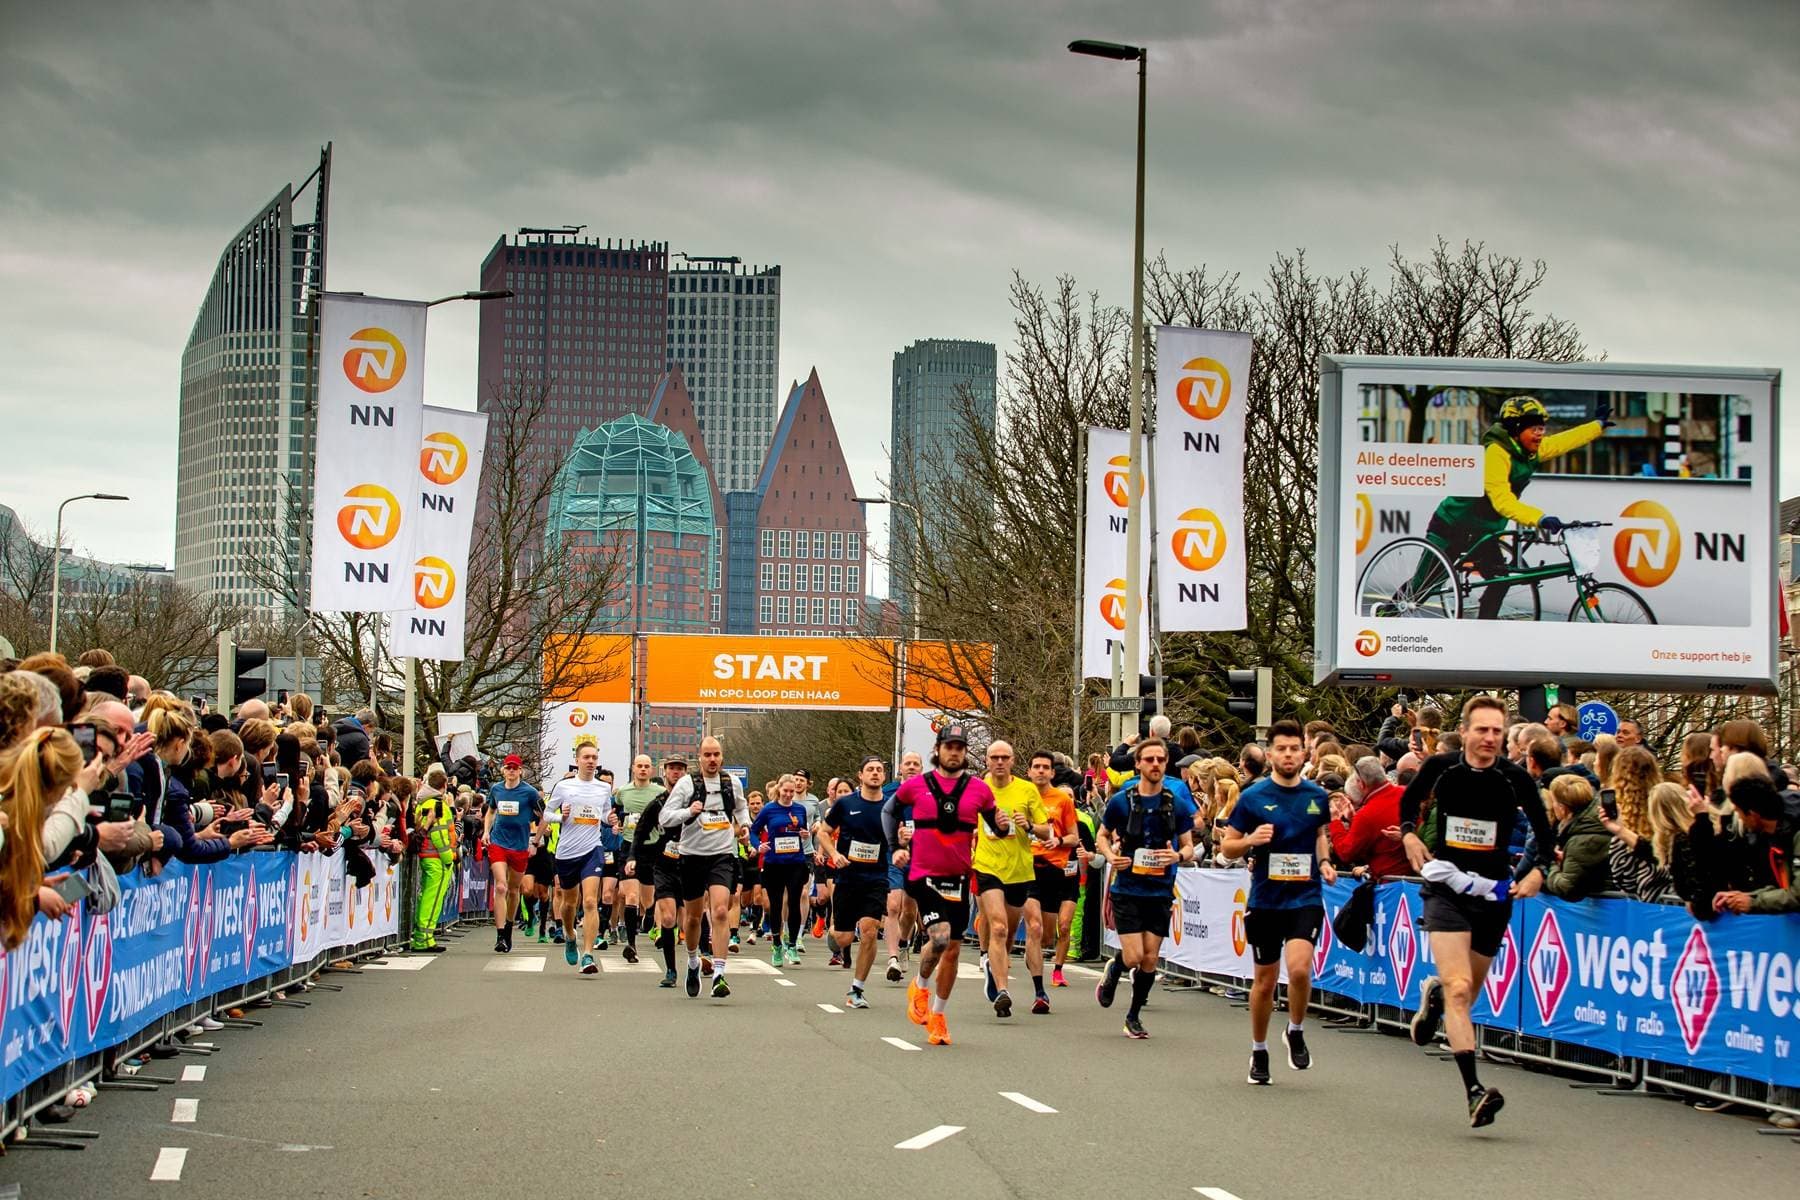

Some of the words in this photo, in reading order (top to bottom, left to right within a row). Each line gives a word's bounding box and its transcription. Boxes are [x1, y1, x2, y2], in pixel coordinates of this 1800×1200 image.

[350, 404, 395, 427] NN
[1184, 431, 1220, 454] NN
[1357, 451, 1385, 465] Alle
[1388, 453, 1475, 468] deelnemers
[1357, 472, 1387, 485] veel
[1391, 473, 1446, 486] succes!
[422, 492, 454, 514] NN
[1379, 509, 1410, 535] NN
[1694, 531, 1745, 562] NN
[344, 561, 389, 584] NN
[1178, 582, 1219, 603] NN
[411, 616, 446, 637] NN
[1386, 634, 1428, 644] nationale
[1386, 645, 1443, 653] nederlanden
[713, 653, 828, 681] START
[1651, 649, 1678, 660] Onze
[1680, 651, 1719, 663] support
[1721, 651, 1740, 662] heb
[1741, 652, 1752, 664] je
[699, 688, 717, 698] NN
[720, 689, 744, 698] CPC
[746, 689, 778, 699] LOOP
[780, 690, 804, 699] DEN
[807, 690, 840, 700] HAAG
[1454, 825, 1486, 837] STEVEN
[214, 873, 244, 940] west
[260, 870, 286, 929] west
[11, 918, 62, 1012] west
[1575, 928, 1667, 1000] west
[1574, 1000, 1607, 1026] online
[1616, 1010, 1628, 1032] tv
[1636, 1011, 1665, 1037] radio
[1725, 1023, 1765, 1054] online
[1775, 1034, 1790, 1058] tv
